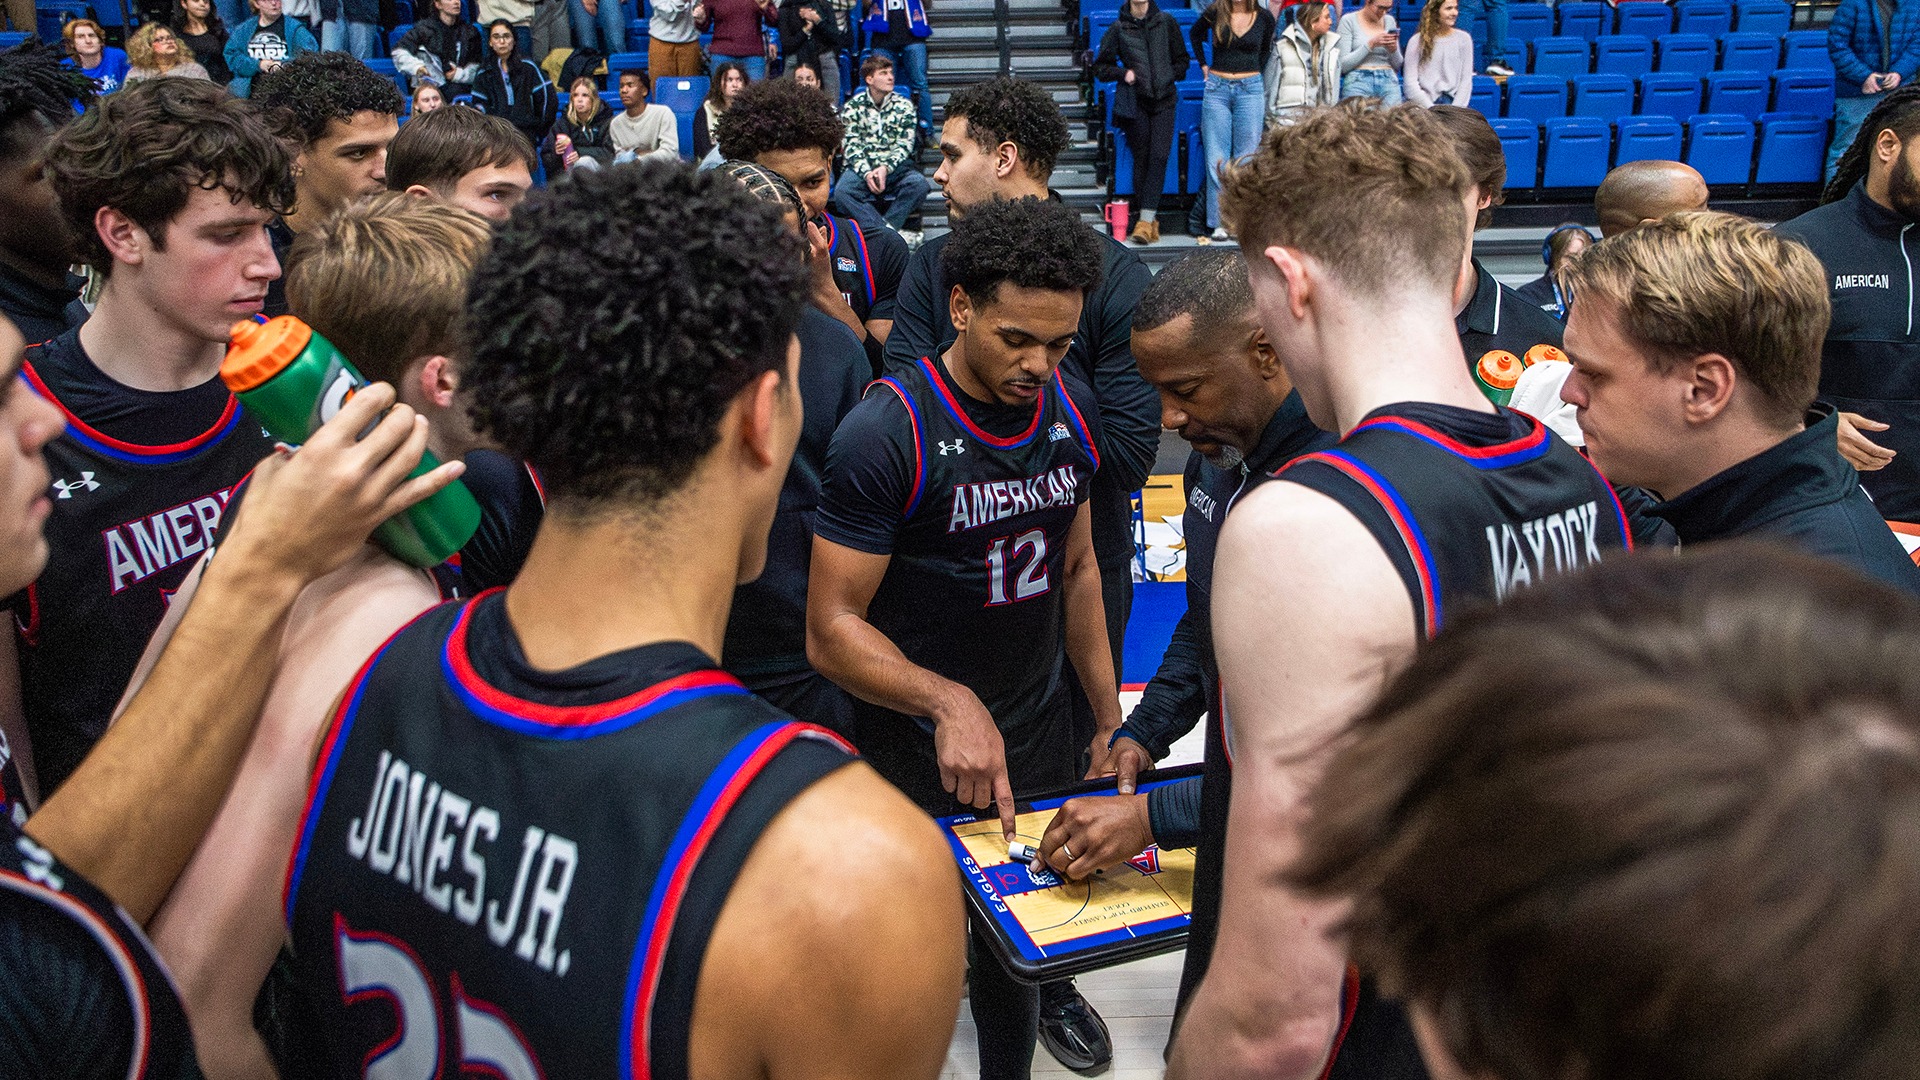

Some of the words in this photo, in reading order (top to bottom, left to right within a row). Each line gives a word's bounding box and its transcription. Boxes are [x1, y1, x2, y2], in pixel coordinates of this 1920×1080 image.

[1834, 274, 1890, 290] AMERICAN
[947, 464, 1078, 533] AMERICAN
[101, 486, 231, 596] AMER
[984, 527, 1051, 607] 12
[347, 749, 500, 926] JONES
[486, 825, 579, 978] JR.
[962, 855, 1009, 914] EAGLES
